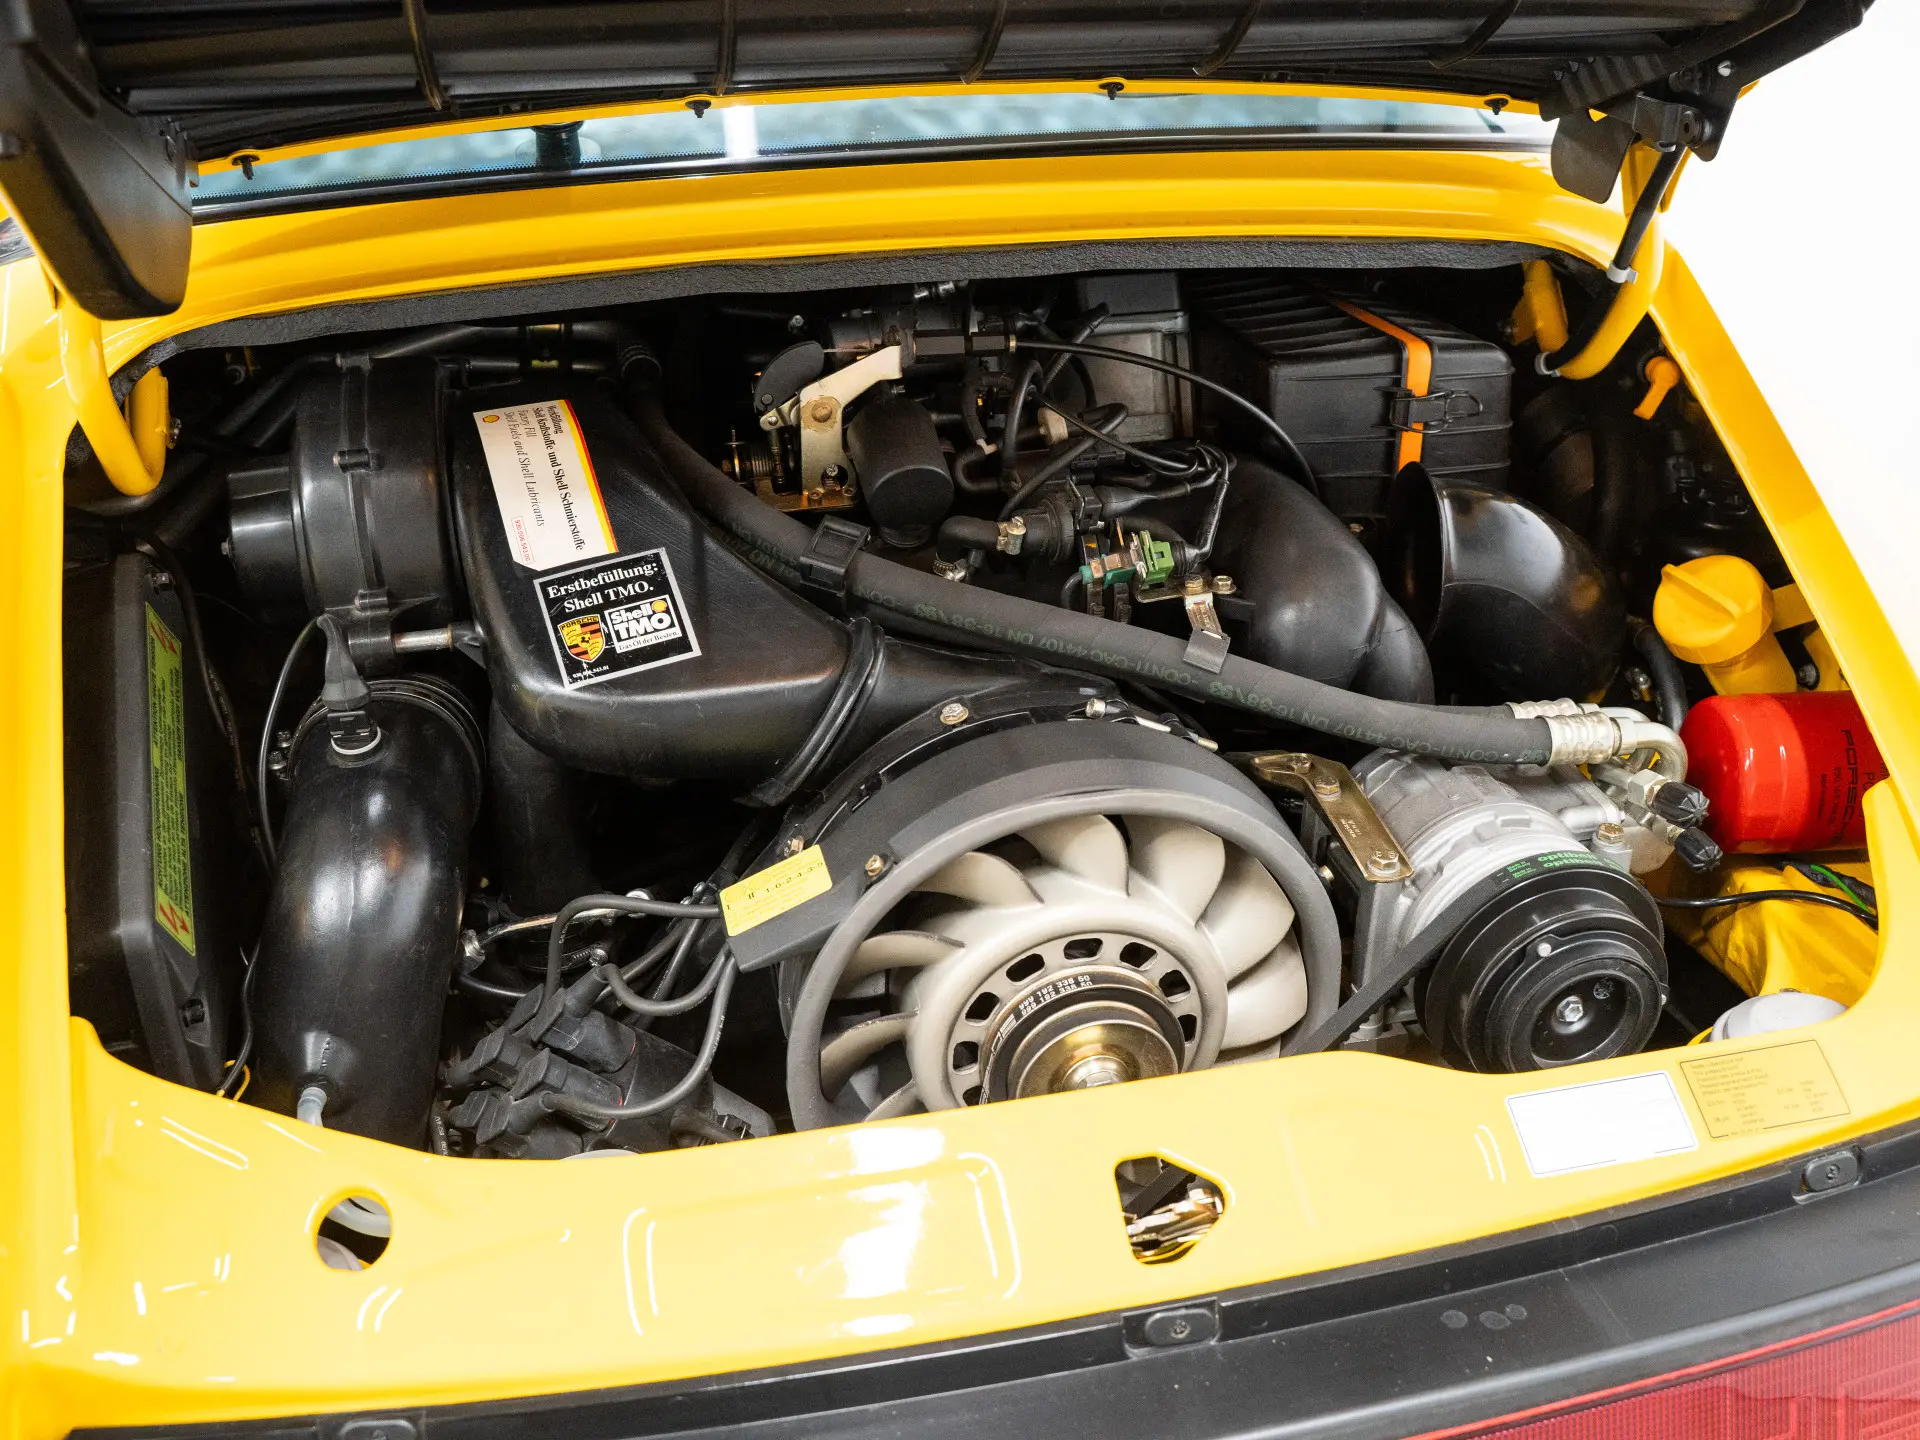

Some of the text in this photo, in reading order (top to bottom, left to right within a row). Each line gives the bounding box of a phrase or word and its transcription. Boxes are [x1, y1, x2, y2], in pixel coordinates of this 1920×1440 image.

[508, 423, 521, 440] Fuels
[524, 427, 536, 438] Fill
[514, 440, 527, 456] and
[518, 457, 534, 478] Shell
[548, 452, 561, 468] und
[553, 469, 568, 491] Shell
[525, 481, 544, 526] Lubricants
[560, 492, 584, 550] Schmierstoffe
[547, 562, 658, 599] Erstbefüllung:
[564, 581, 654, 612] Shell TMO.
[610, 602, 653, 624] Shell
[614, 612, 671, 640] TMO
[1007, 629, 1034, 646] DN
[1040, 636, 1087, 658] 44107
[1301, 711, 1329, 730] DN
[1334, 720, 1388, 746] 44107
[1018, 996, 1034, 1010] 999
[1036, 985, 1054, 997] 192
[1056, 978, 1074, 988] 338
[1021, 1002, 1037, 1017] 999
